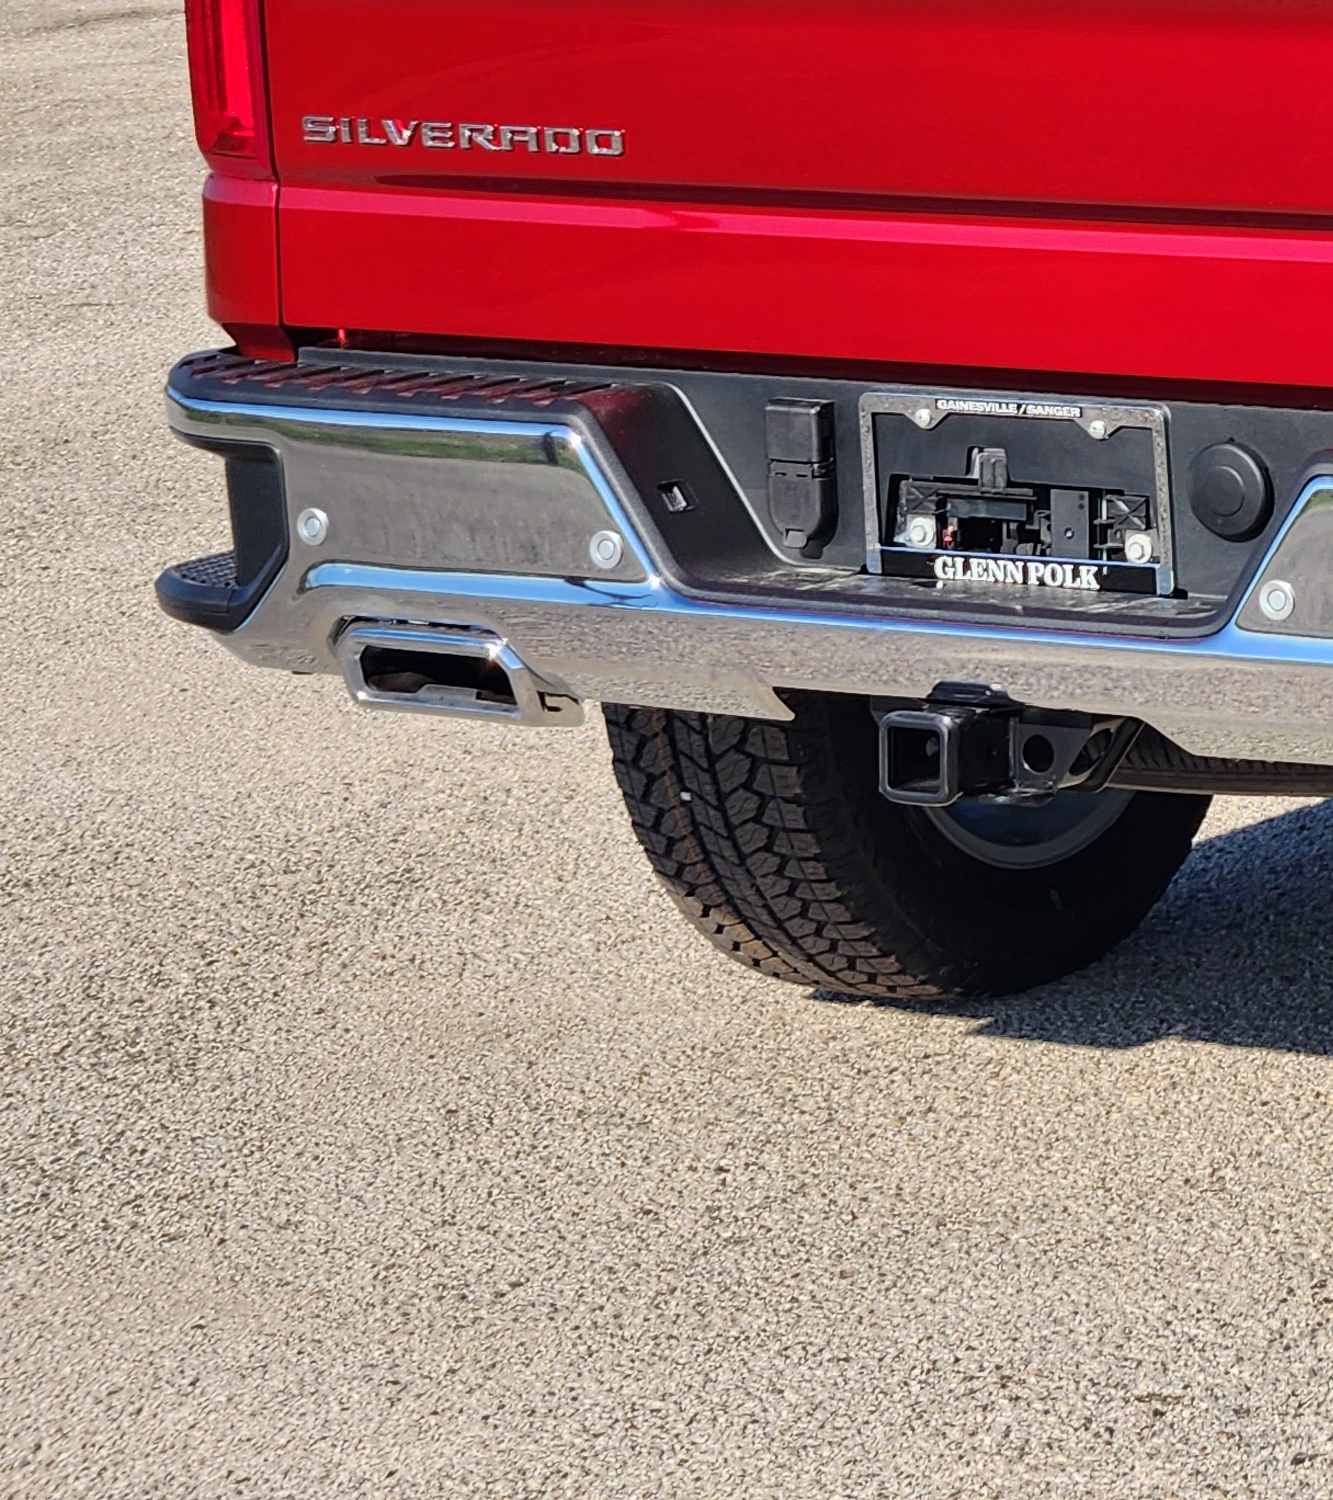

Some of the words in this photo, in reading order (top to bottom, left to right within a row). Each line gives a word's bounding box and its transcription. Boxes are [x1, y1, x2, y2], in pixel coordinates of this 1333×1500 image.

[302, 115, 626, 158] SILVERADO
[933, 555, 1025, 584] GLENN
[1027, 562, 1100, 591] POLK
